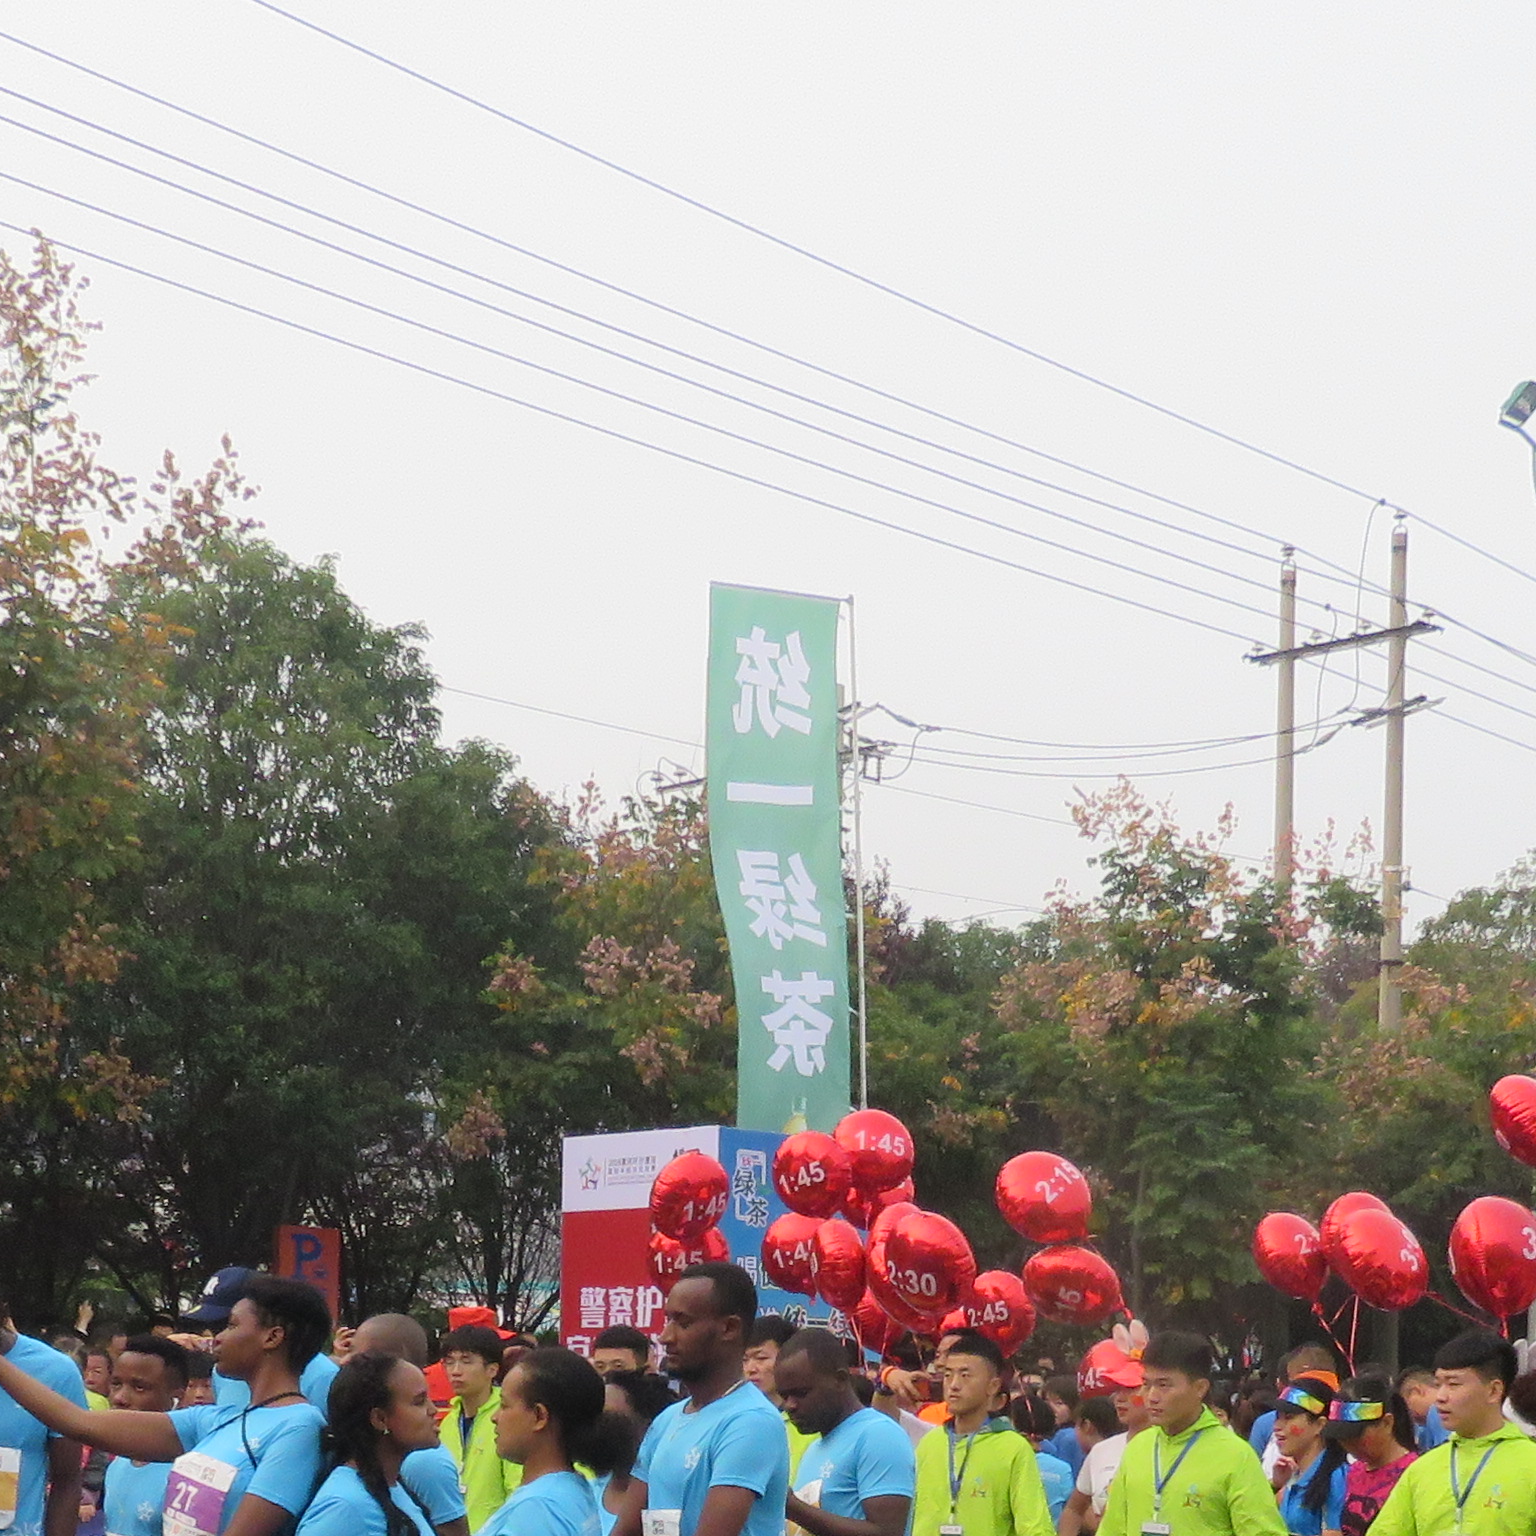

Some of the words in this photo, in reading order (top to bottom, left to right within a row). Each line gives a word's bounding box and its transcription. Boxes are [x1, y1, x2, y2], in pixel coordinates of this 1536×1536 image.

[855, 1130, 905, 1157] 1:45
[778, 1161, 825, 1195] 1:45
[1035, 1161, 1082, 1204] 2:15
[683, 1192, 727, 1221] 1:45
[290, 1233, 323, 1279] P
[653, 1250, 704, 1274] 1:45
[887, 1260, 937, 1296] 2:30
[967, 1300, 1009, 1328] 2:45
[172, 1481, 199, 1512] 27
